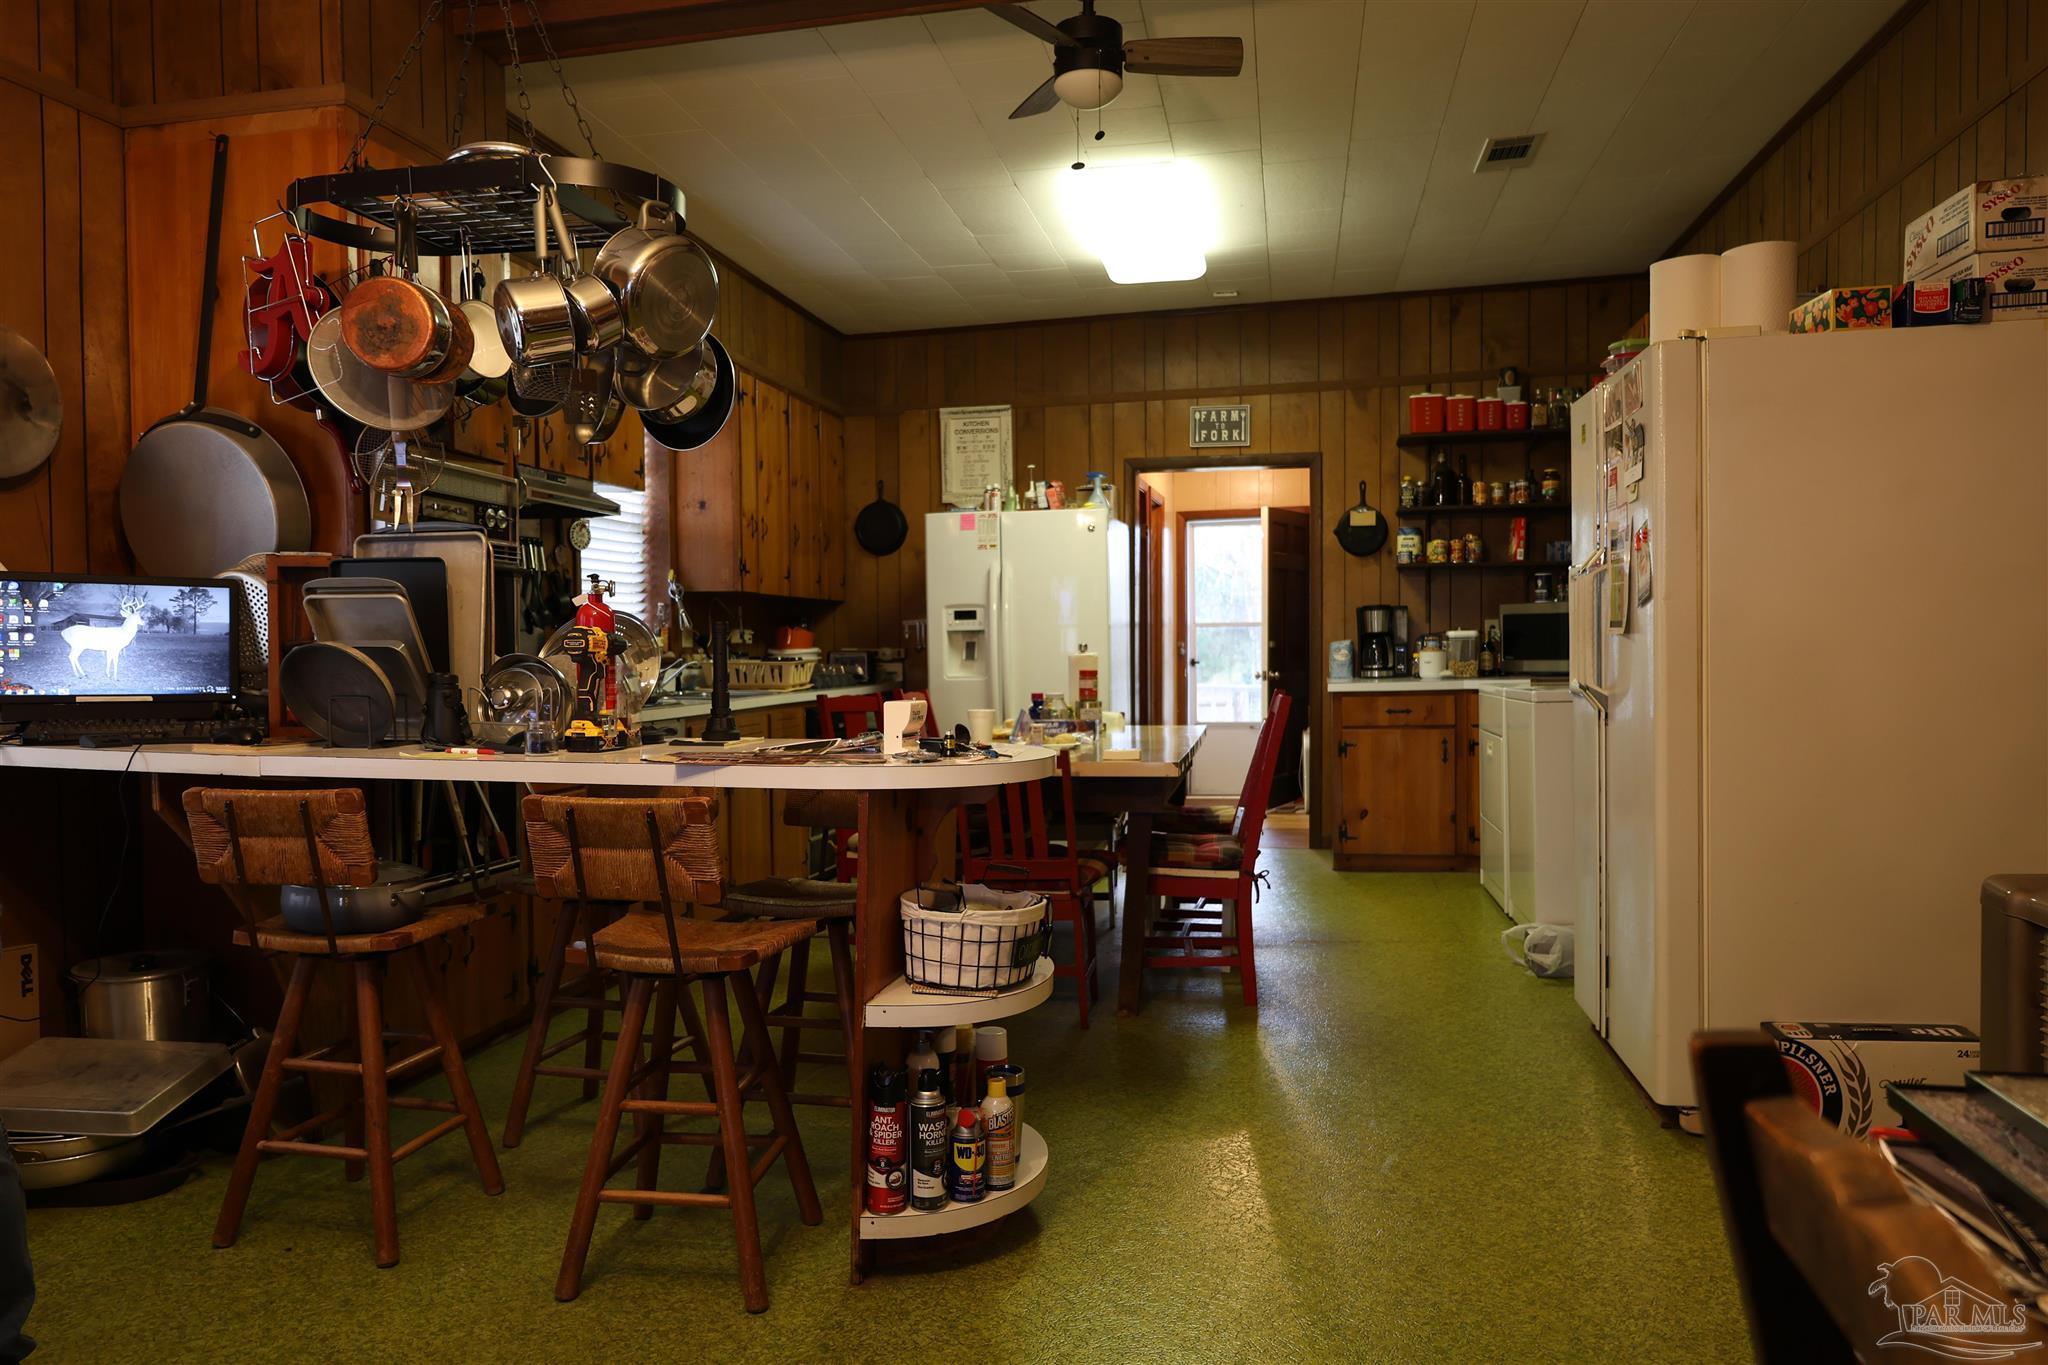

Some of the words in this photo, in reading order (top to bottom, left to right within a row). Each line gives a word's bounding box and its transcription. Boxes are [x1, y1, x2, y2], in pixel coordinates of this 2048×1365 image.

[1982, 184, 2021, 212] SYSCO
[1905, 215, 1934, 273] SYSCO
[1984, 256, 2024, 283] SYSCO
[1200, 410, 1240, 423] FARM
[962, 420, 990, 428] KITCHEN
[954, 428, 999, 436] CONVERSIONS
[1200, 429, 1240, 442] FORK
[20, 953, 34, 998] DELL
[1957, 1049, 1970, 1058] 24
[1780, 1041, 1838, 1098] PILSNER
[871, 1121, 900, 1132] ROACH
[874, 1115, 895, 1125] ANT,
[873, 1130, 903, 1139] SPIDER
[956, 1143, 984, 1160] WD-40
